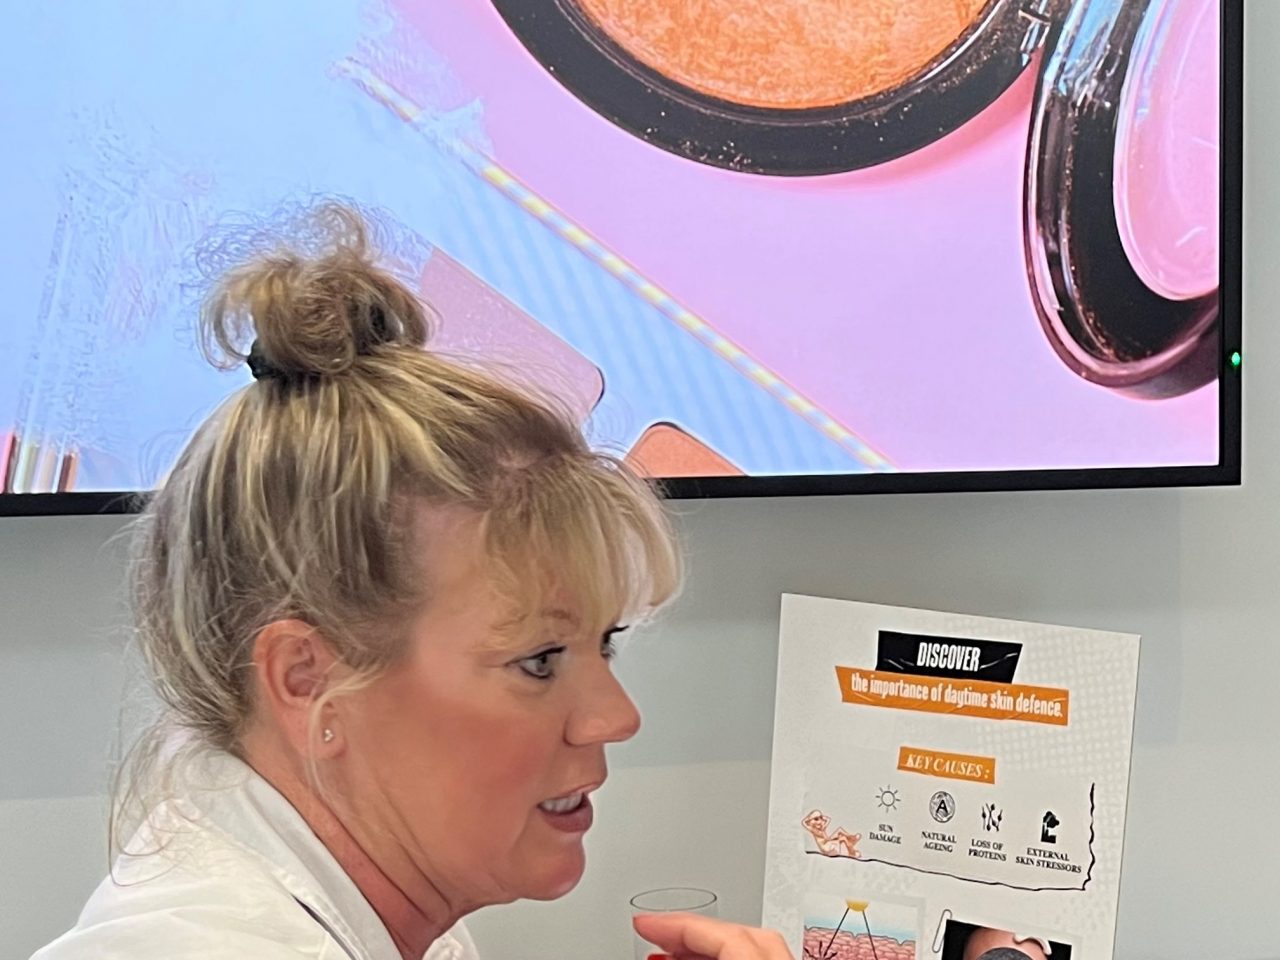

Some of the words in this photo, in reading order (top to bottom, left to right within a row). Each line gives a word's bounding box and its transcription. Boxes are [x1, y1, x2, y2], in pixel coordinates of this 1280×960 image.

[917, 642, 981, 672] DISCOVER
[851, 673, 868, 692] the
[870, 675, 928, 701] importance
[931, 684, 944, 701] of
[944, 686, 988, 708] daytime
[990, 690, 1014, 711] skin
[906, 754, 933, 770] KEY
[933, 757, 982, 778] CAUSES
[878, 824, 893, 833] SUN
[869, 832, 901, 845] DAMAGE
[921, 831, 957, 844] NATURAL
[923, 842, 953, 853] AGEING
[971, 838, 989, 849] LOSS
[991, 841, 1003, 851] OF
[968, 849, 1007, 862] PROTEINS
[1026, 847, 1070, 862] EXTERNAL
[1016, 856, 1035, 867] SKIN
[1036, 859, 1082, 873] STRESSORS
